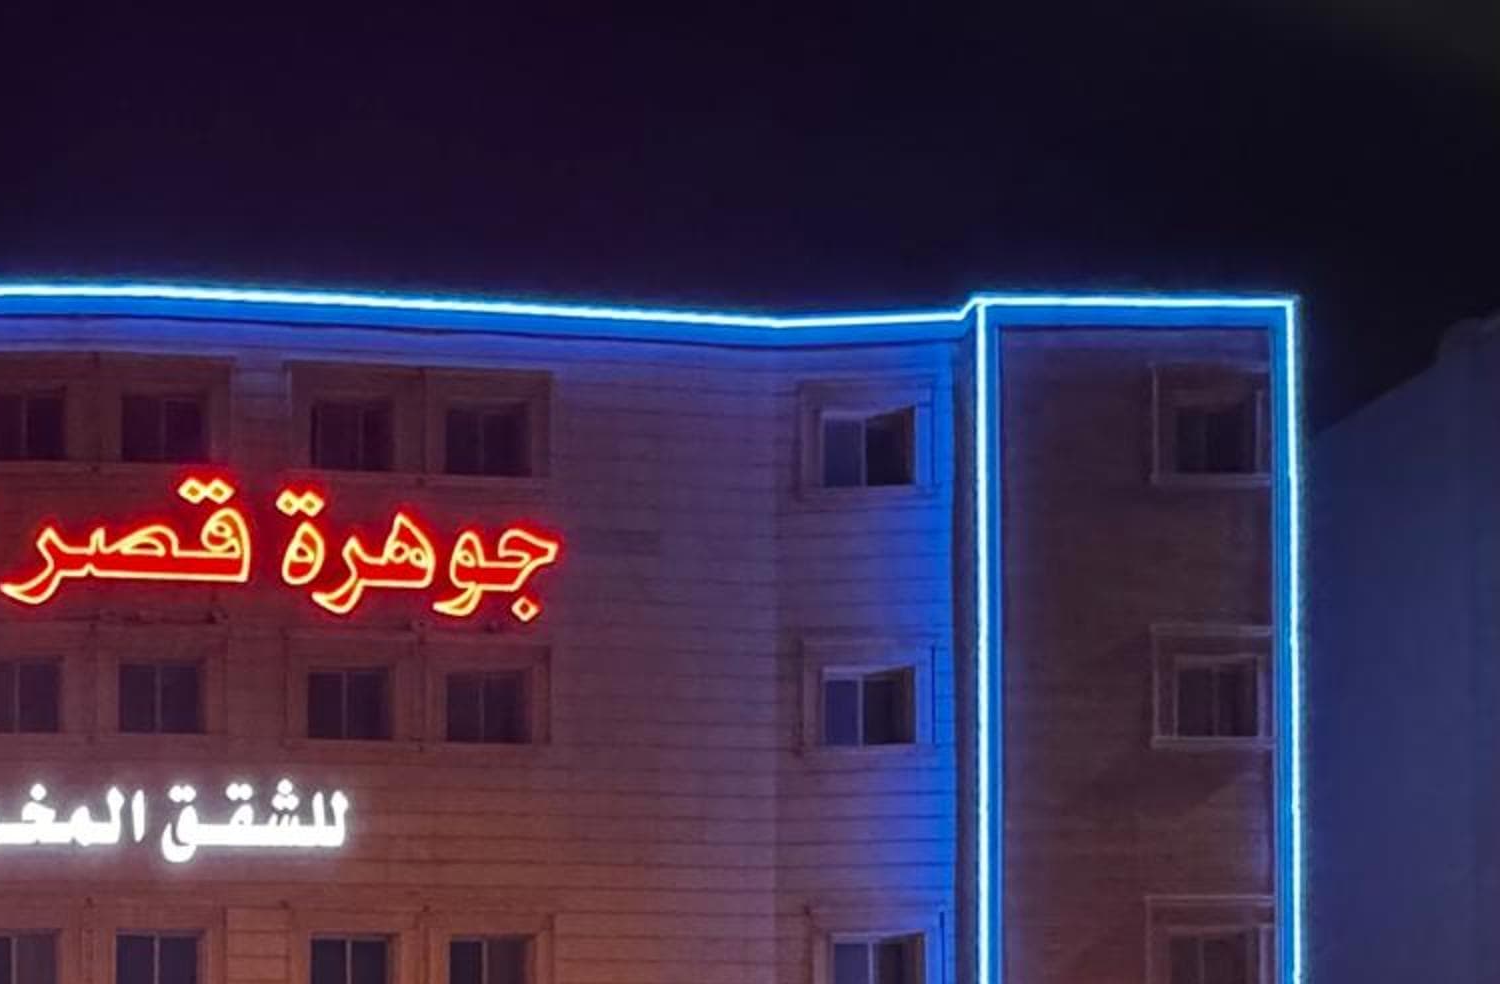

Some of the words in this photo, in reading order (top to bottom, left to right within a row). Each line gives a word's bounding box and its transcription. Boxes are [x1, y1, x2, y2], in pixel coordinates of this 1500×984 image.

[0, 476, 252, 605] قصر
[275, 489, 560, 622] جوهرة
[160, 779, 350, 863] للشقق
